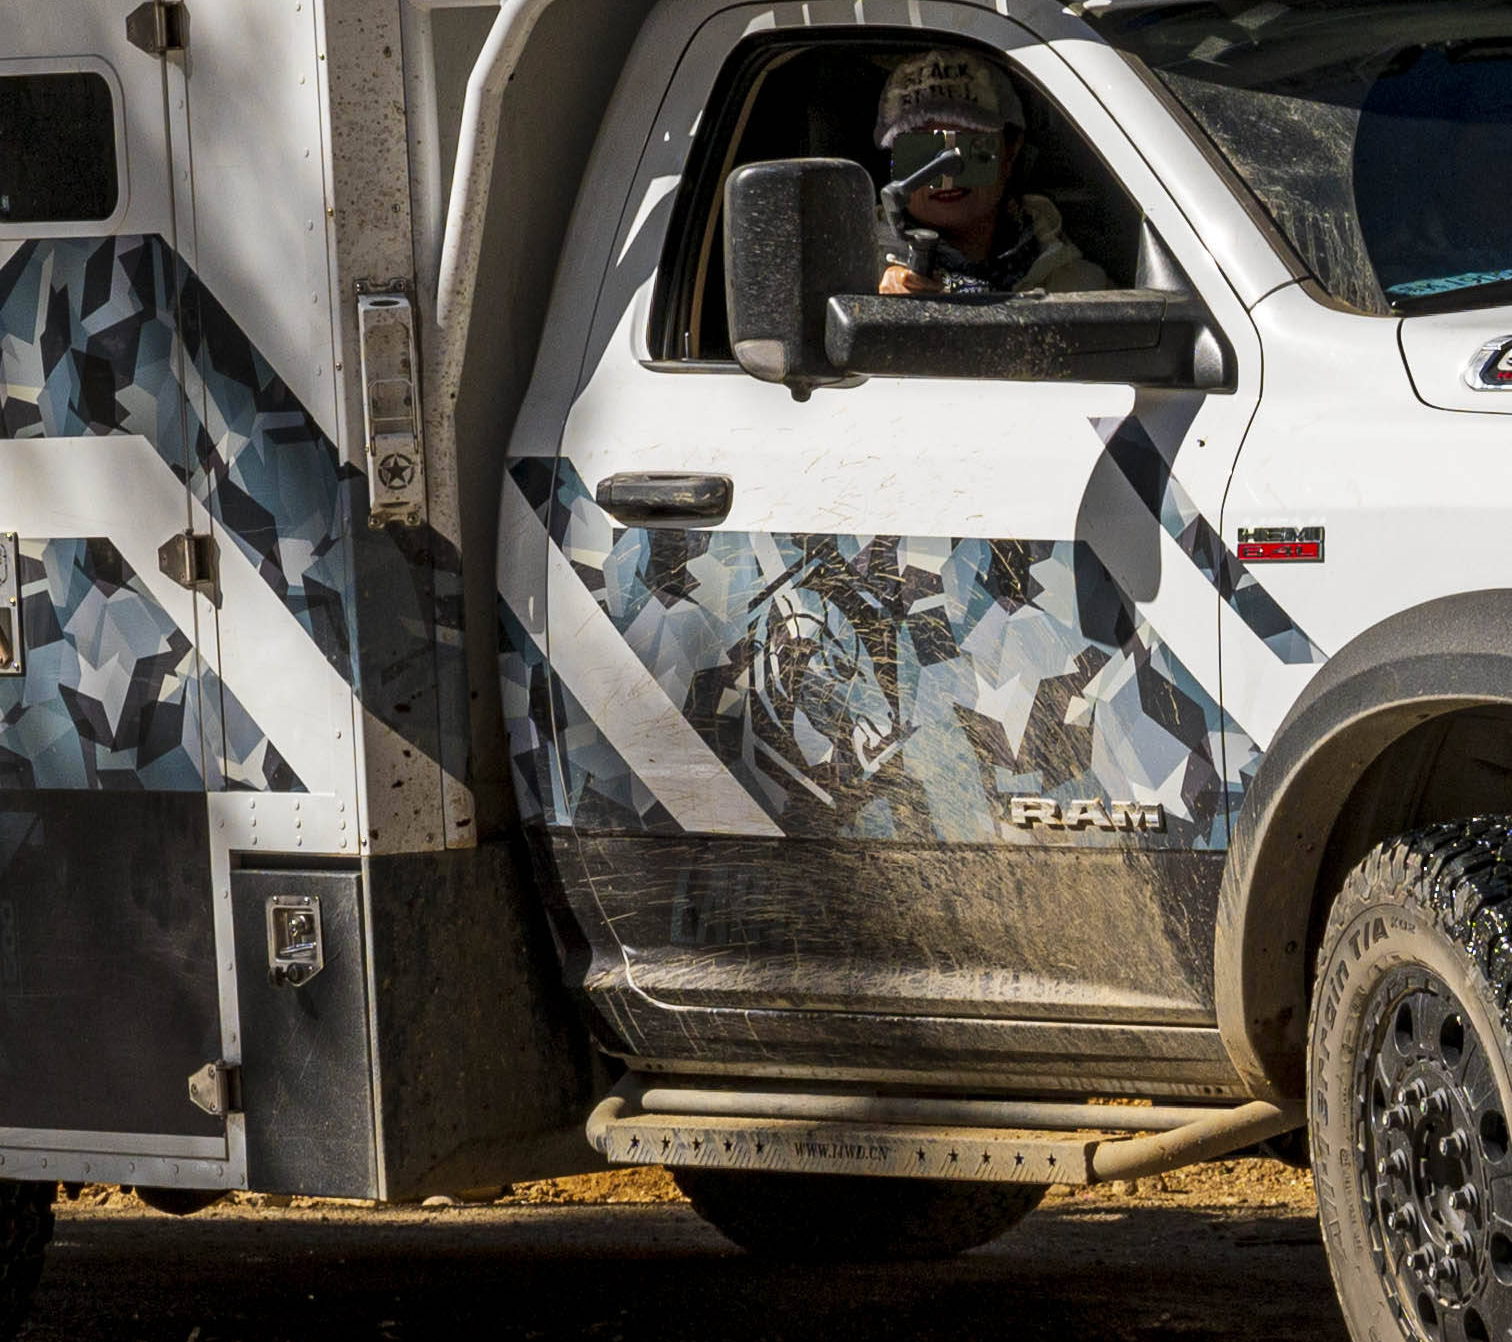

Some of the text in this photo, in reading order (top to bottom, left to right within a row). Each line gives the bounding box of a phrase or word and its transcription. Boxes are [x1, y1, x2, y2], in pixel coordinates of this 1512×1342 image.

[1237, 525, 1324, 543] HEMI
[1011, 797, 1168, 834] RAM
[1348, 916, 1389, 961] T/A
